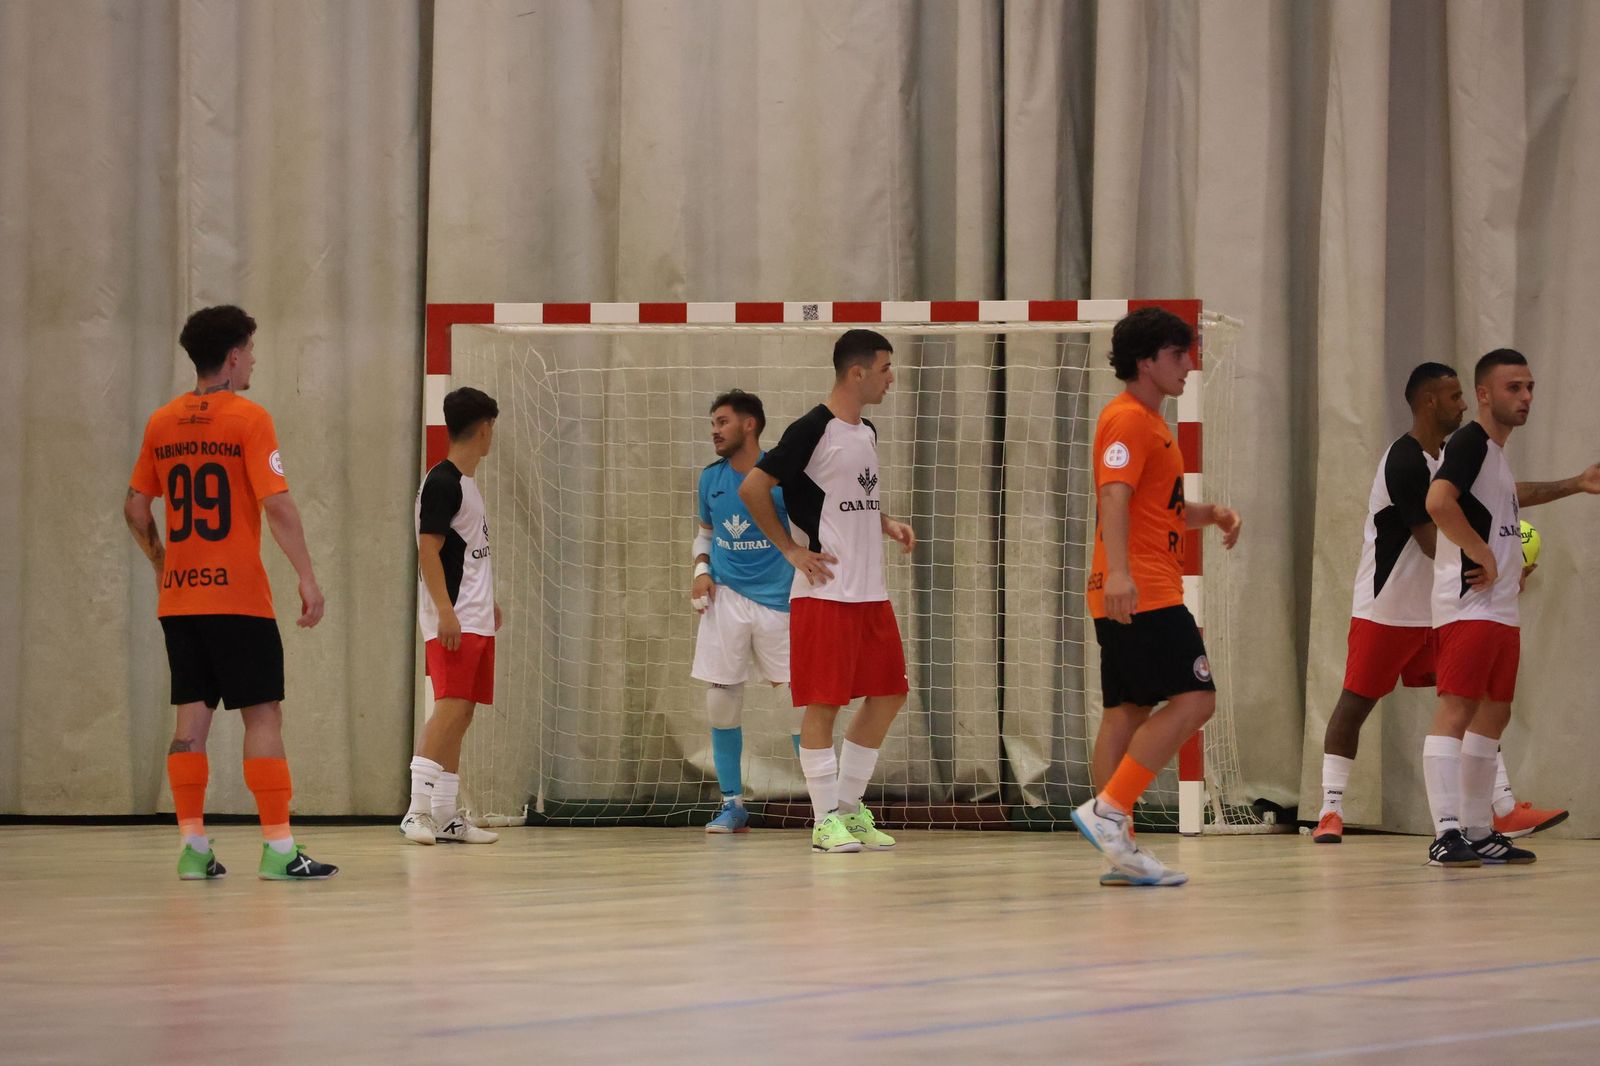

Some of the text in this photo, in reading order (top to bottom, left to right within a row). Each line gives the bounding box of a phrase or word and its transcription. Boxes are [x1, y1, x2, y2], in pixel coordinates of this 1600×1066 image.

[201, 441, 242, 458] ROCHA
[167, 462, 231, 542] 99
[732, 539, 771, 551] RURAL
[163, 567, 230, 589] uvesa
